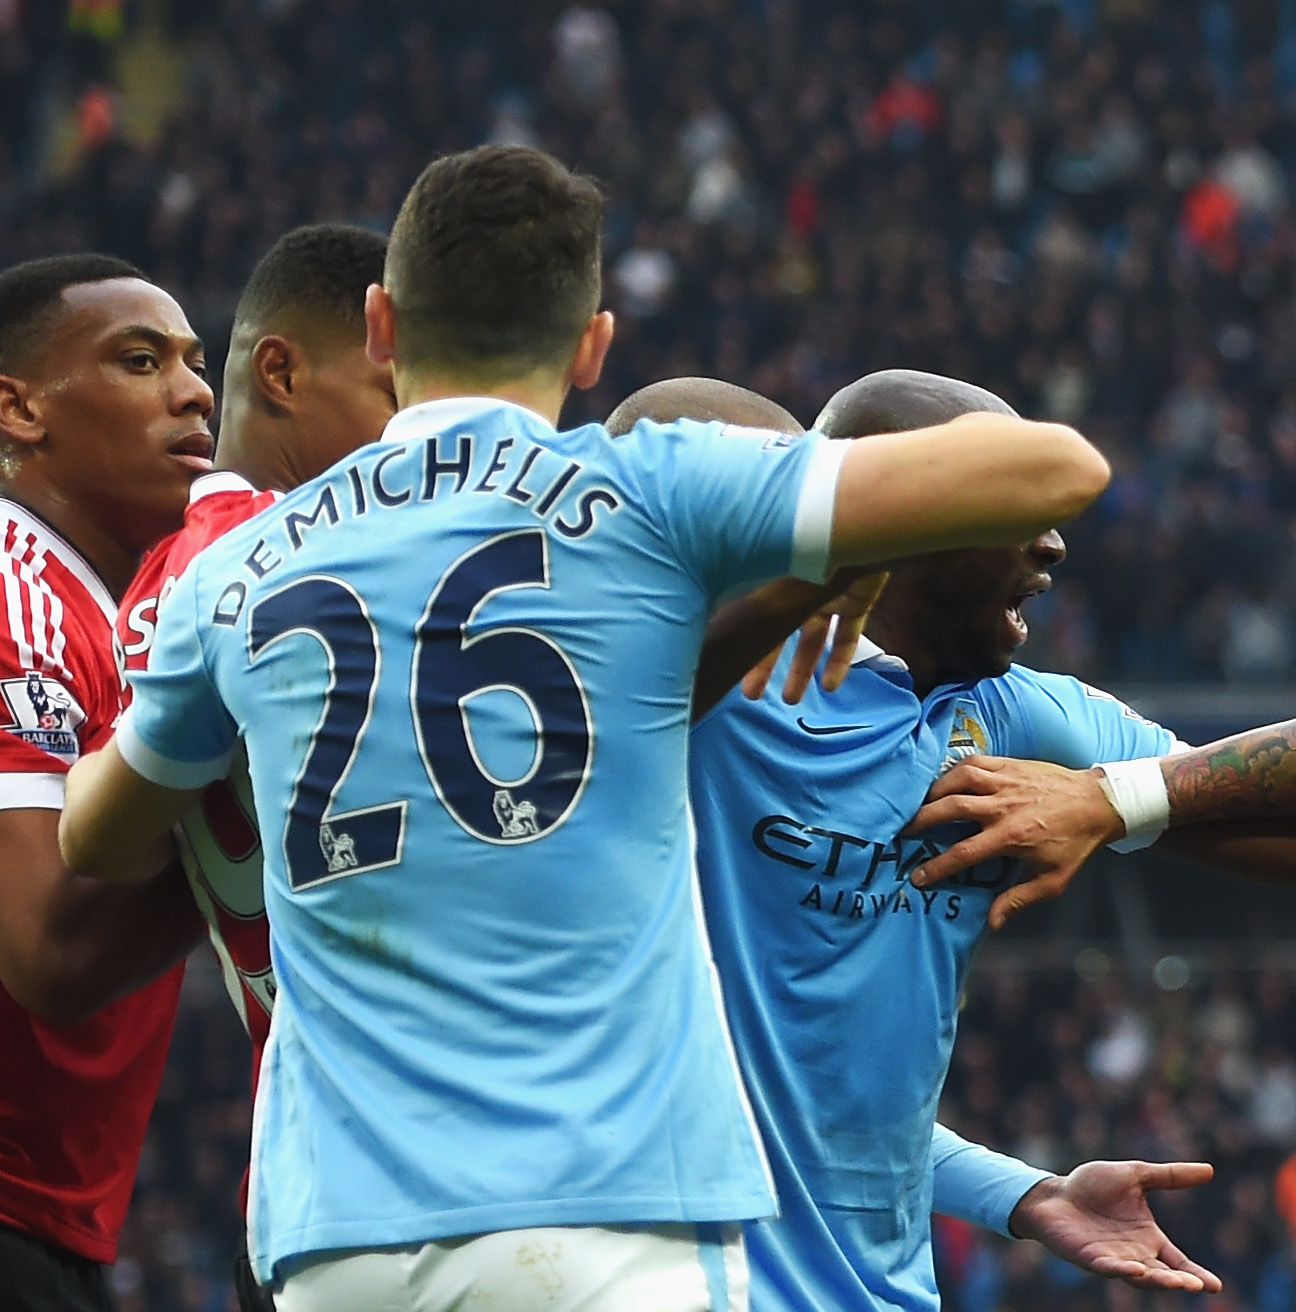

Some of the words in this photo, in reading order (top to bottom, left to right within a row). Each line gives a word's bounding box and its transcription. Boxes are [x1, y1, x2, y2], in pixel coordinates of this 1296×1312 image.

[211, 436, 621, 628] DEMICHELIS
[249, 528, 593, 892] 26
[799, 883, 962, 921] AIRWAYS
